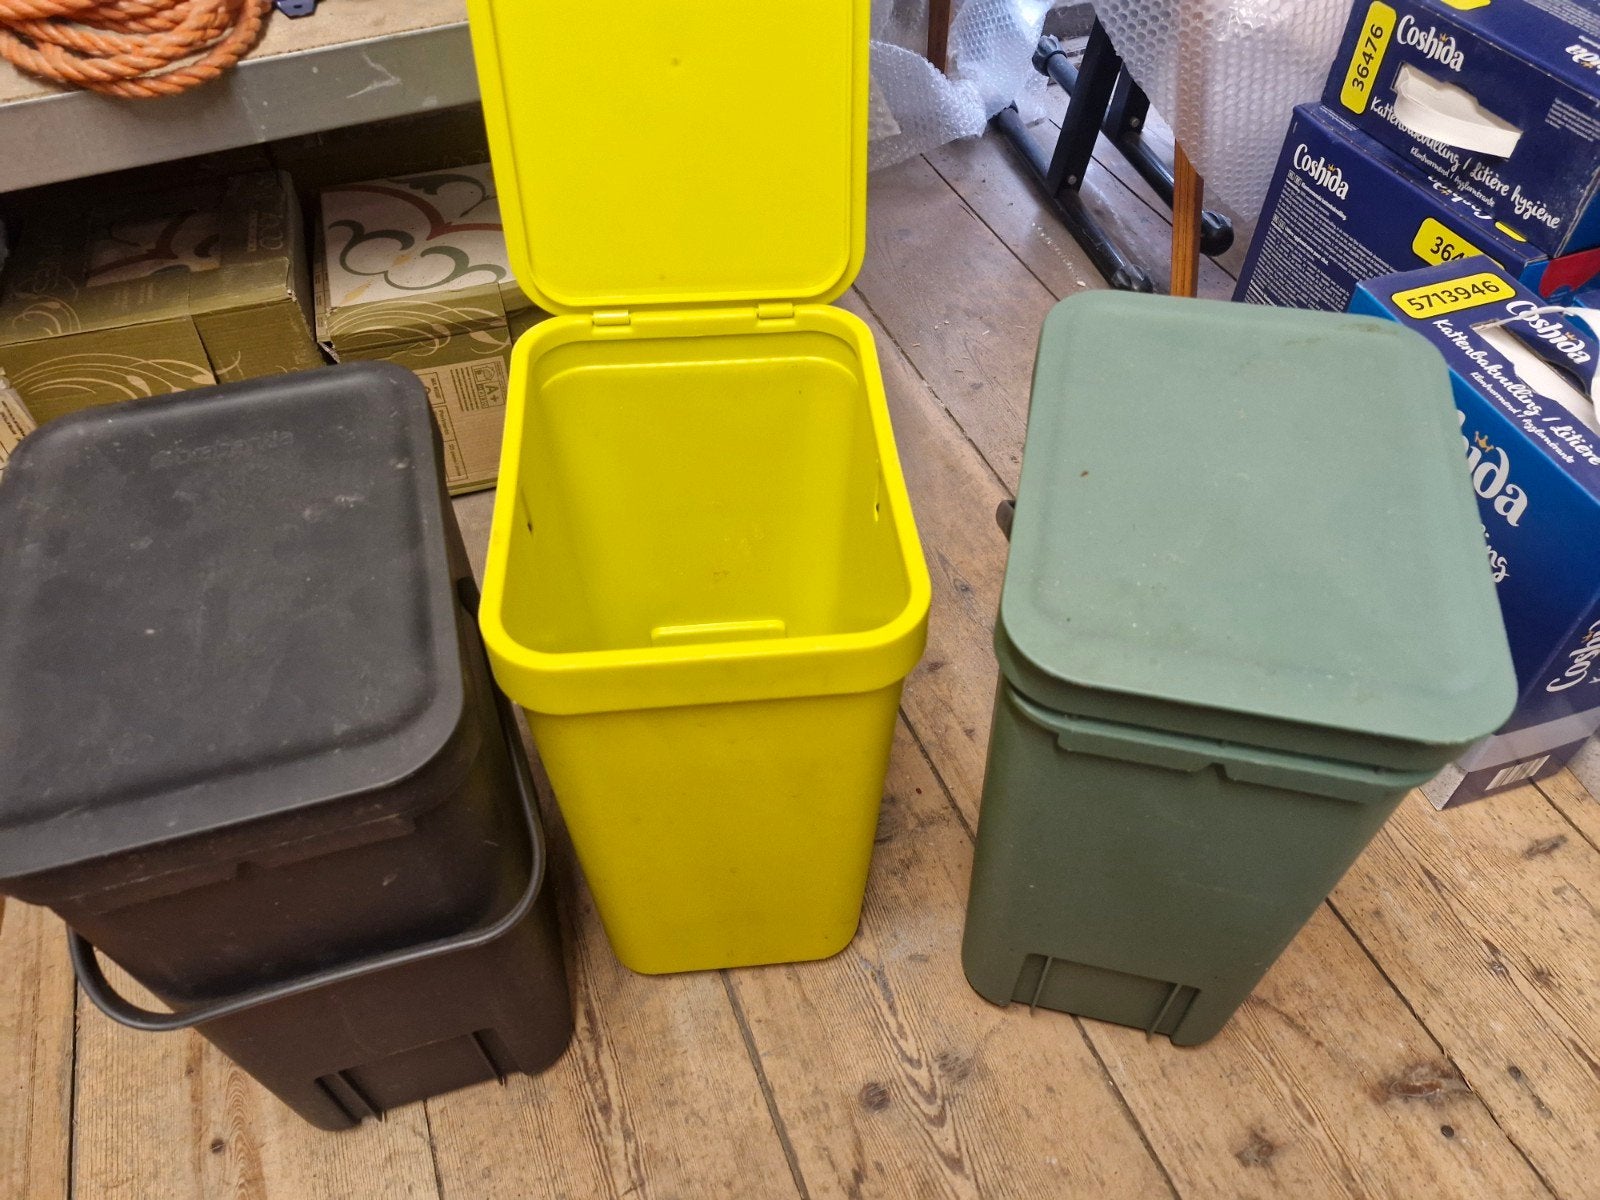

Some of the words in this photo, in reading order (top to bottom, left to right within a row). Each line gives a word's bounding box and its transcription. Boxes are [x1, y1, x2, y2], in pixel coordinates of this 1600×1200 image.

[1352, 23, 1384, 92] 36476
[1396, 14, 1465, 72] Coshida
[1293, 143, 1349, 200] Coshida
[1511, 185, 1562, 230] hygiène
[1406, 280, 1500, 311] 5713946
[1505, 300, 1591, 364] Coshida
[1432, 319, 1544, 417] Kattenbakvulling
